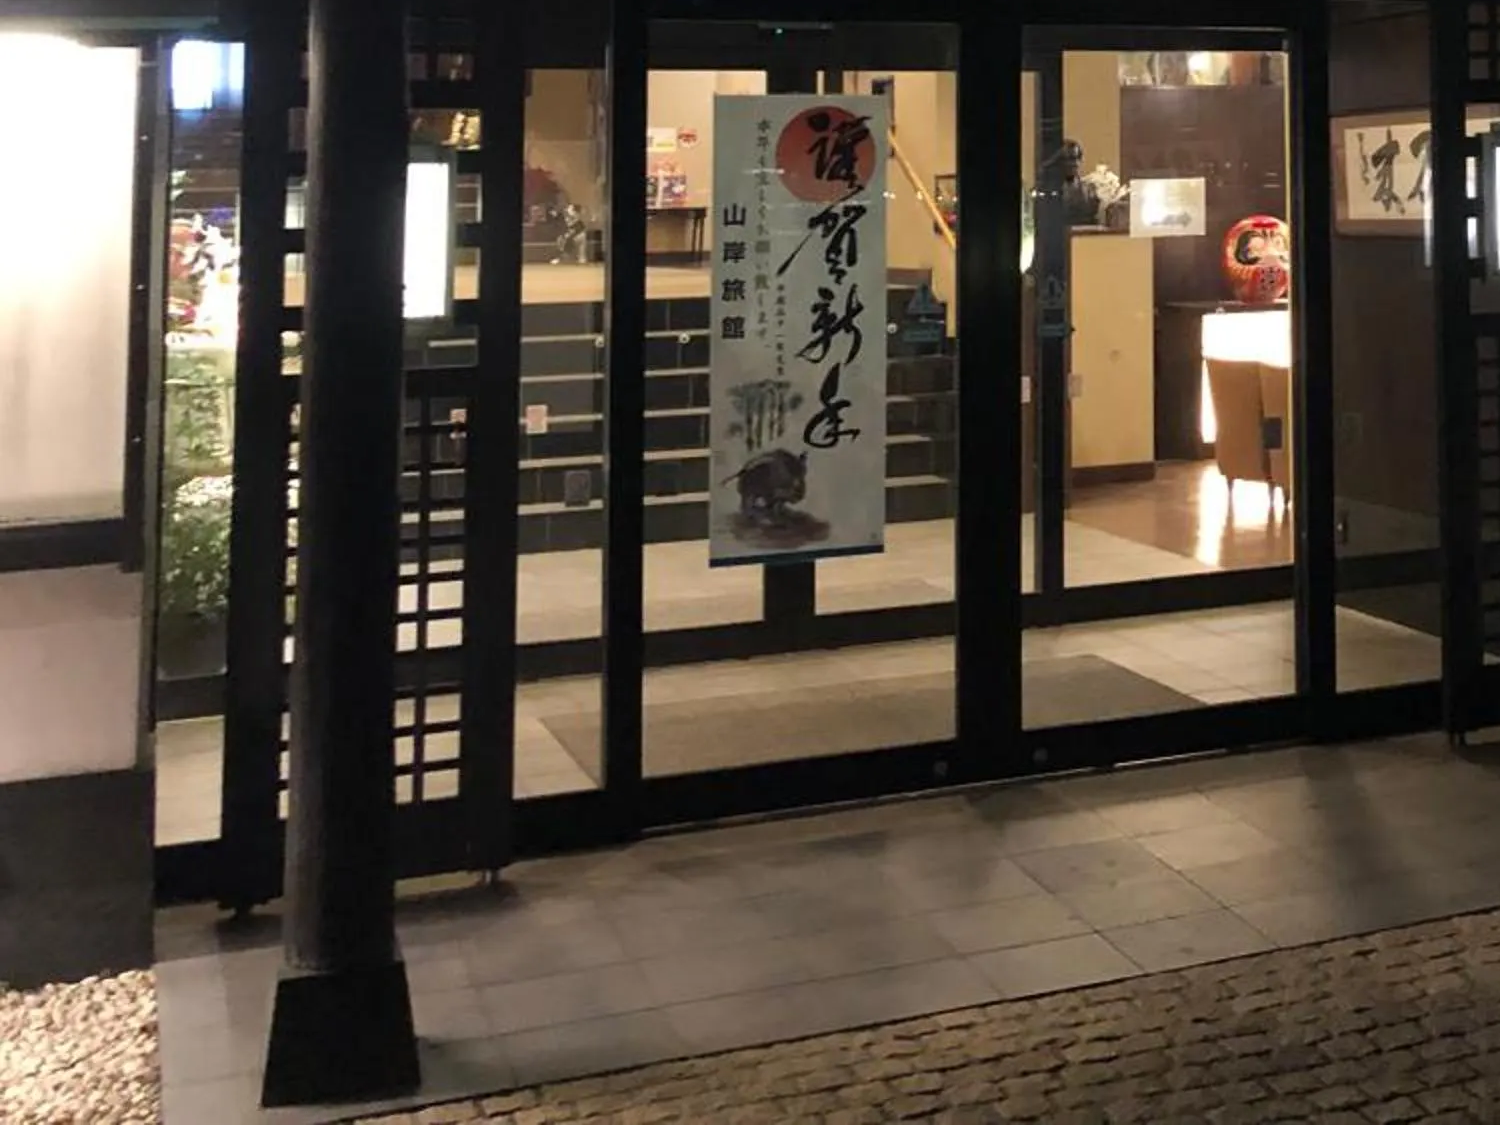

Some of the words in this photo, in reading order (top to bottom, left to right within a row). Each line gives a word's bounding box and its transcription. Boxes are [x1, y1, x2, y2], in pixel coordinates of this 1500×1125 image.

[721, 203, 748, 341] 山岸旅館
[778, 112, 872, 449] 謹賀新年
